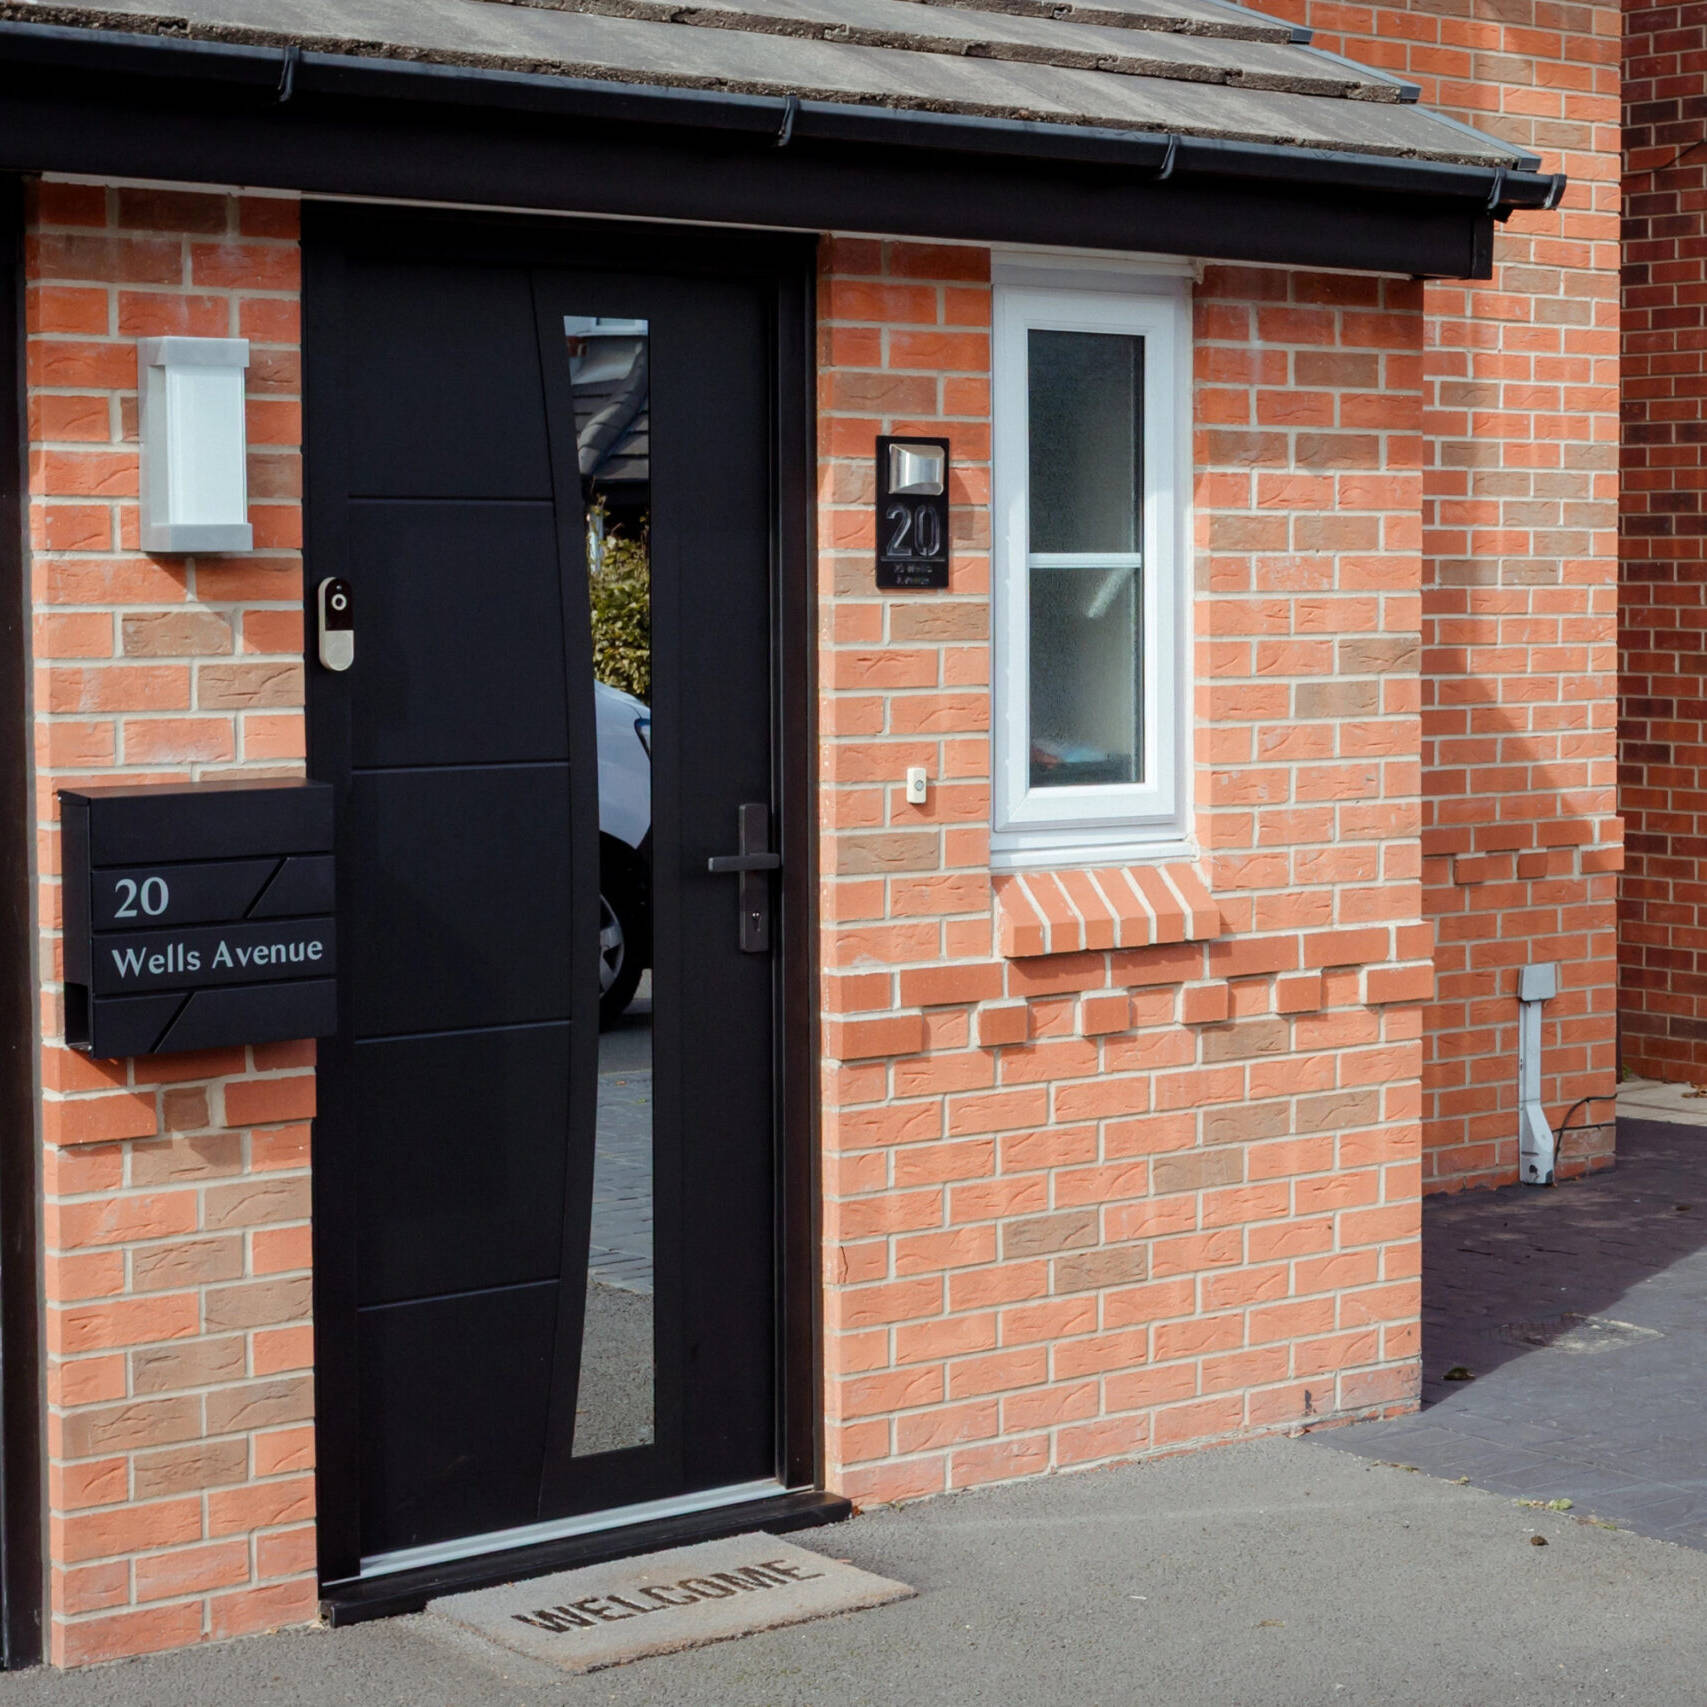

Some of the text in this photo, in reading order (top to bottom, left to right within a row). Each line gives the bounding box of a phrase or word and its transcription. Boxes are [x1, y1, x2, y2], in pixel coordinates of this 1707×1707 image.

[886, 504, 940, 556] 20
[114, 877, 169, 917] 20
[112, 940, 323, 978] Wells Avenue
[512, 1559, 825, 1633] WELCOME
